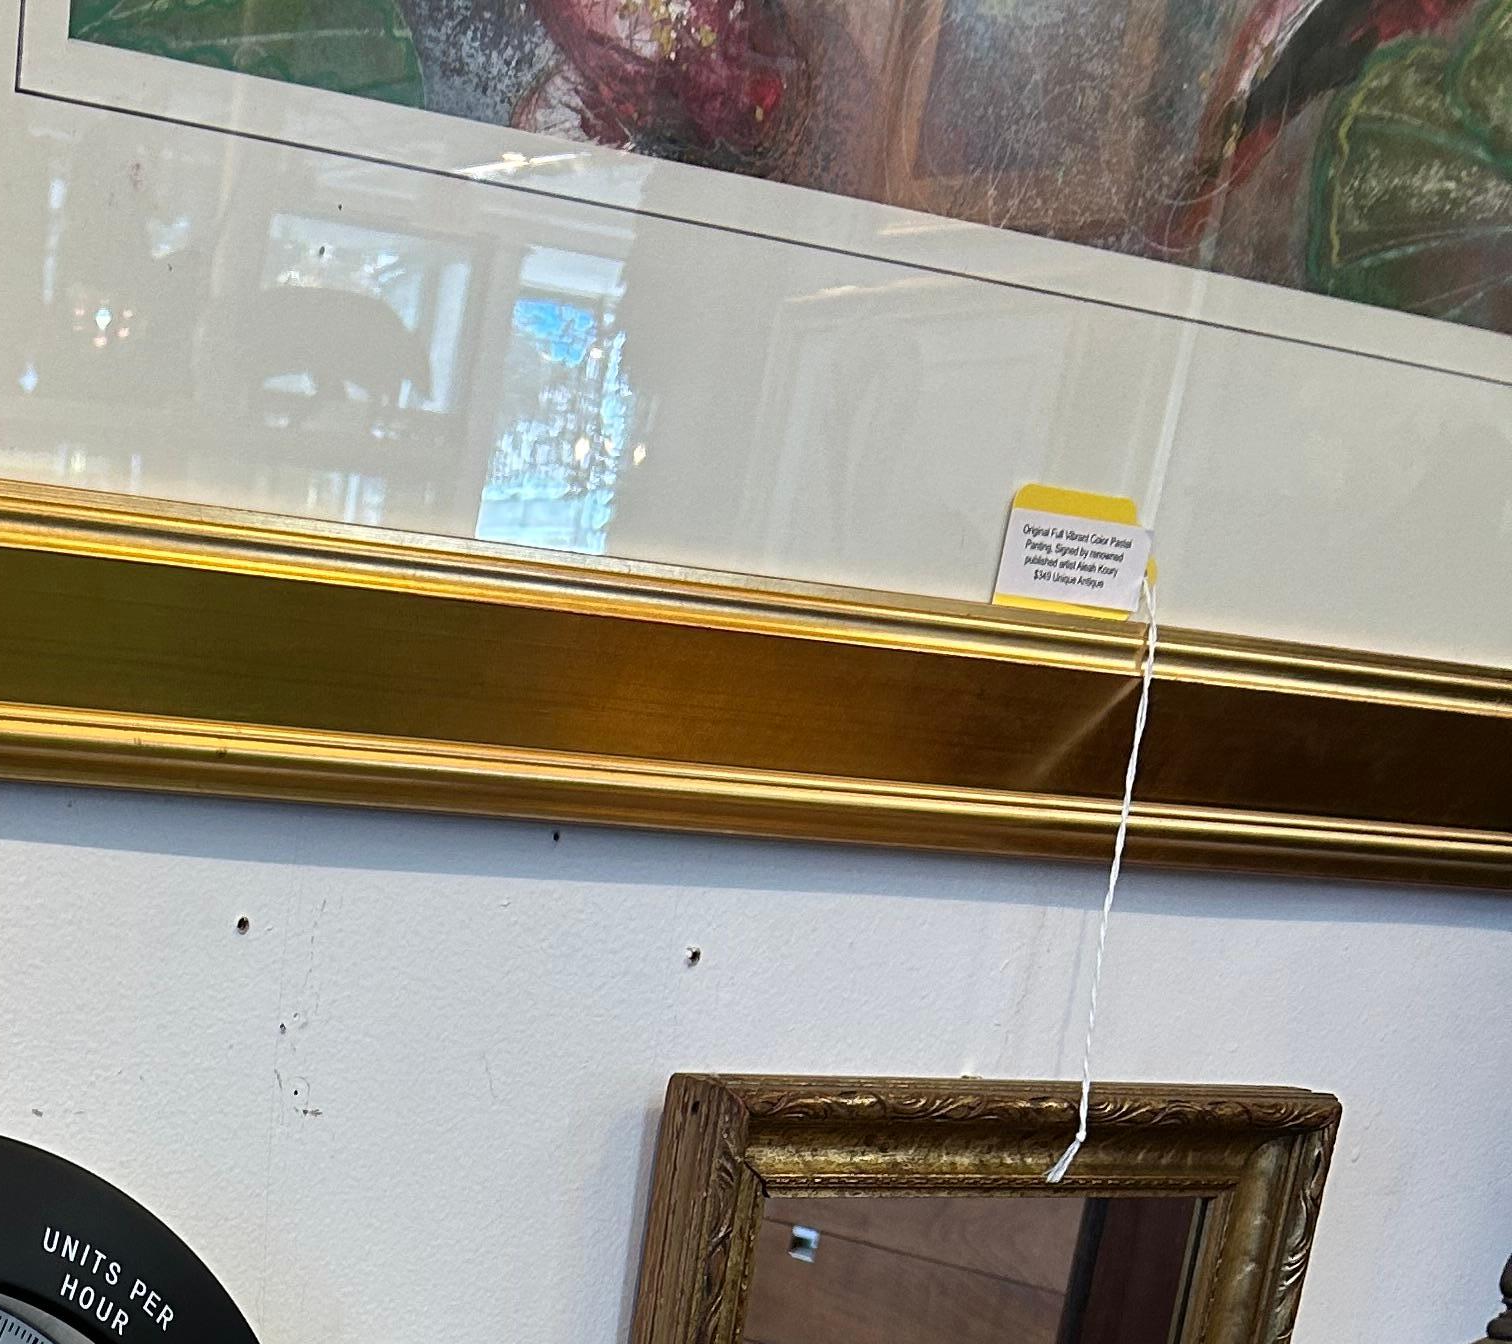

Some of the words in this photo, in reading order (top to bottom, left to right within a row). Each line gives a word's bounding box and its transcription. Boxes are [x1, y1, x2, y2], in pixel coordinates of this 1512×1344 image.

[1023, 524, 1050, 538] Original
[1090, 533, 1110, 546] Color
[1024, 555, 1058, 566] published
[1059, 560, 1076, 570] artist
[1055, 543, 1079, 557] Signed
[1080, 546, 1089, 559] by
[1089, 550, 1124, 562] renowned
[1052, 571, 1077, 585] Unique
[1077, 576, 1104, 589] Antique
[43, 1227, 121, 1285] UNITS
[129, 1278, 174, 1331] PER
[60, 1273, 129, 1336] HOUR
